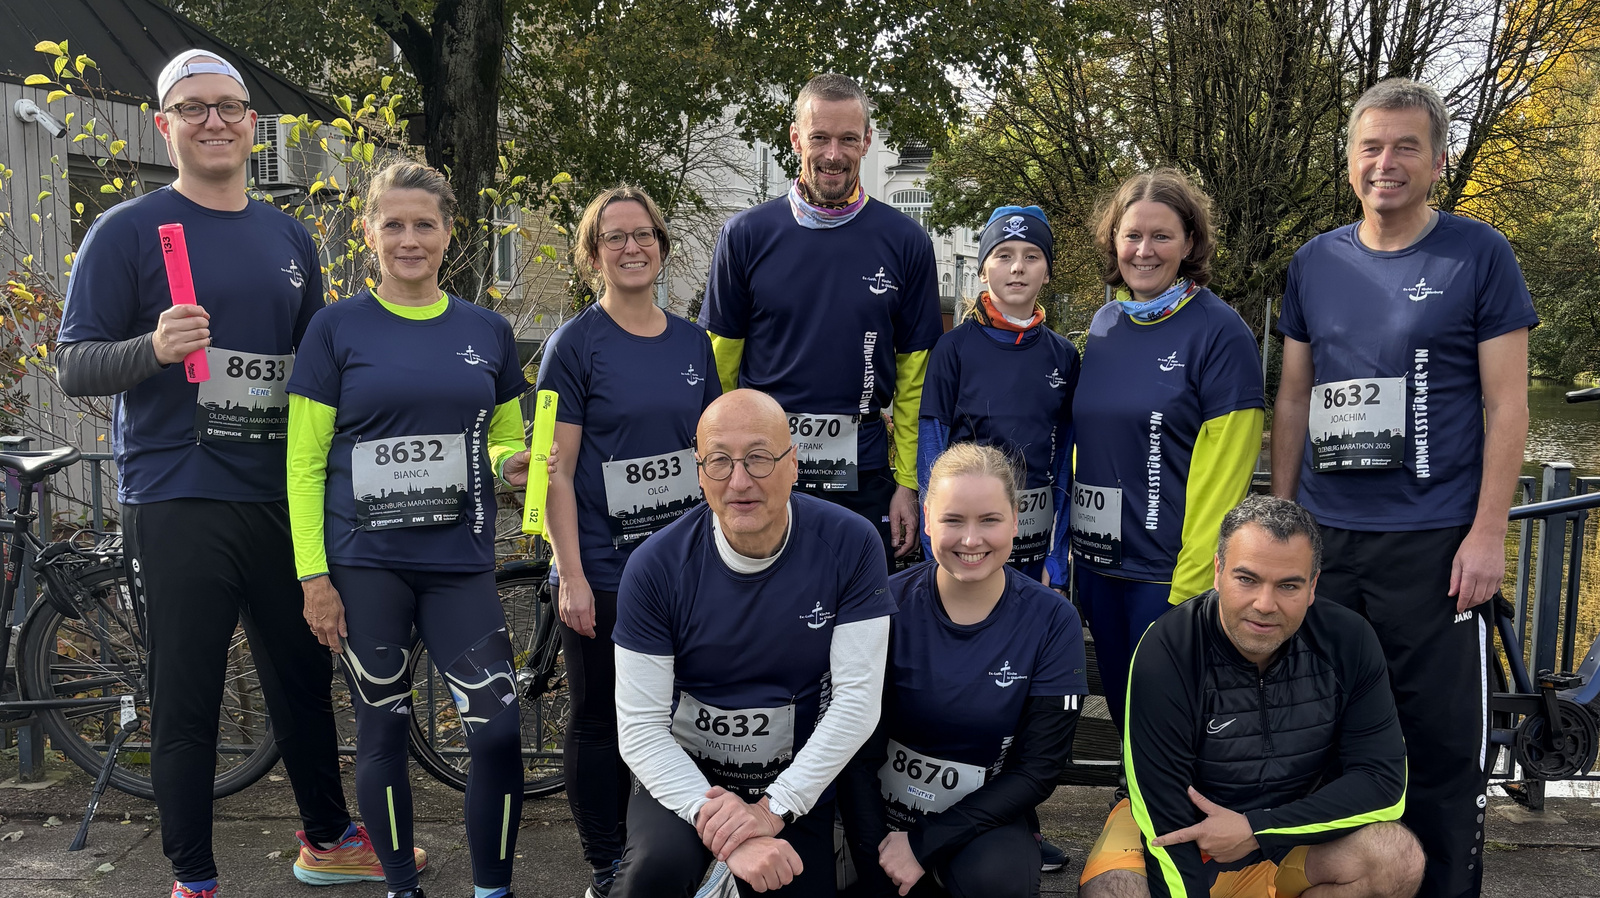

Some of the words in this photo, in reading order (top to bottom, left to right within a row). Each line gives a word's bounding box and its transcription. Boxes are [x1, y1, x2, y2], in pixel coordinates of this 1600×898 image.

[162, 236, 173, 254] 133
[226, 356, 285, 382] 8633
[1324, 383, 1380, 410] 8632
[208, 412, 248, 423] OLDENBURG
[1330, 412, 1366, 424] JOACHIM
[788, 416, 840, 438] 8670
[375, 440, 444, 466] 8632
[394, 469, 430, 480] BIANCA
[626, 456, 682, 484] 8633
[648, 485, 669, 496] OLGA
[1074, 485, 1105, 511] 8670
[368, 500, 406, 512] OLDENBURG
[407, 498, 444, 508] MARATHON
[1018, 492, 1046, 513] 670
[530, 508, 539, 524] 132
[622, 514, 655, 526] OLDENBURG
[656, 509, 685, 520] MARATHON
[1018, 518, 1036, 526] MATS
[1454, 610, 1472, 624] JAKO
[694, 708, 770, 738] 8632
[706, 739, 758, 752] MATTHIAS
[722, 770, 762, 780] MARATHON
[892, 750, 958, 790] 8670
